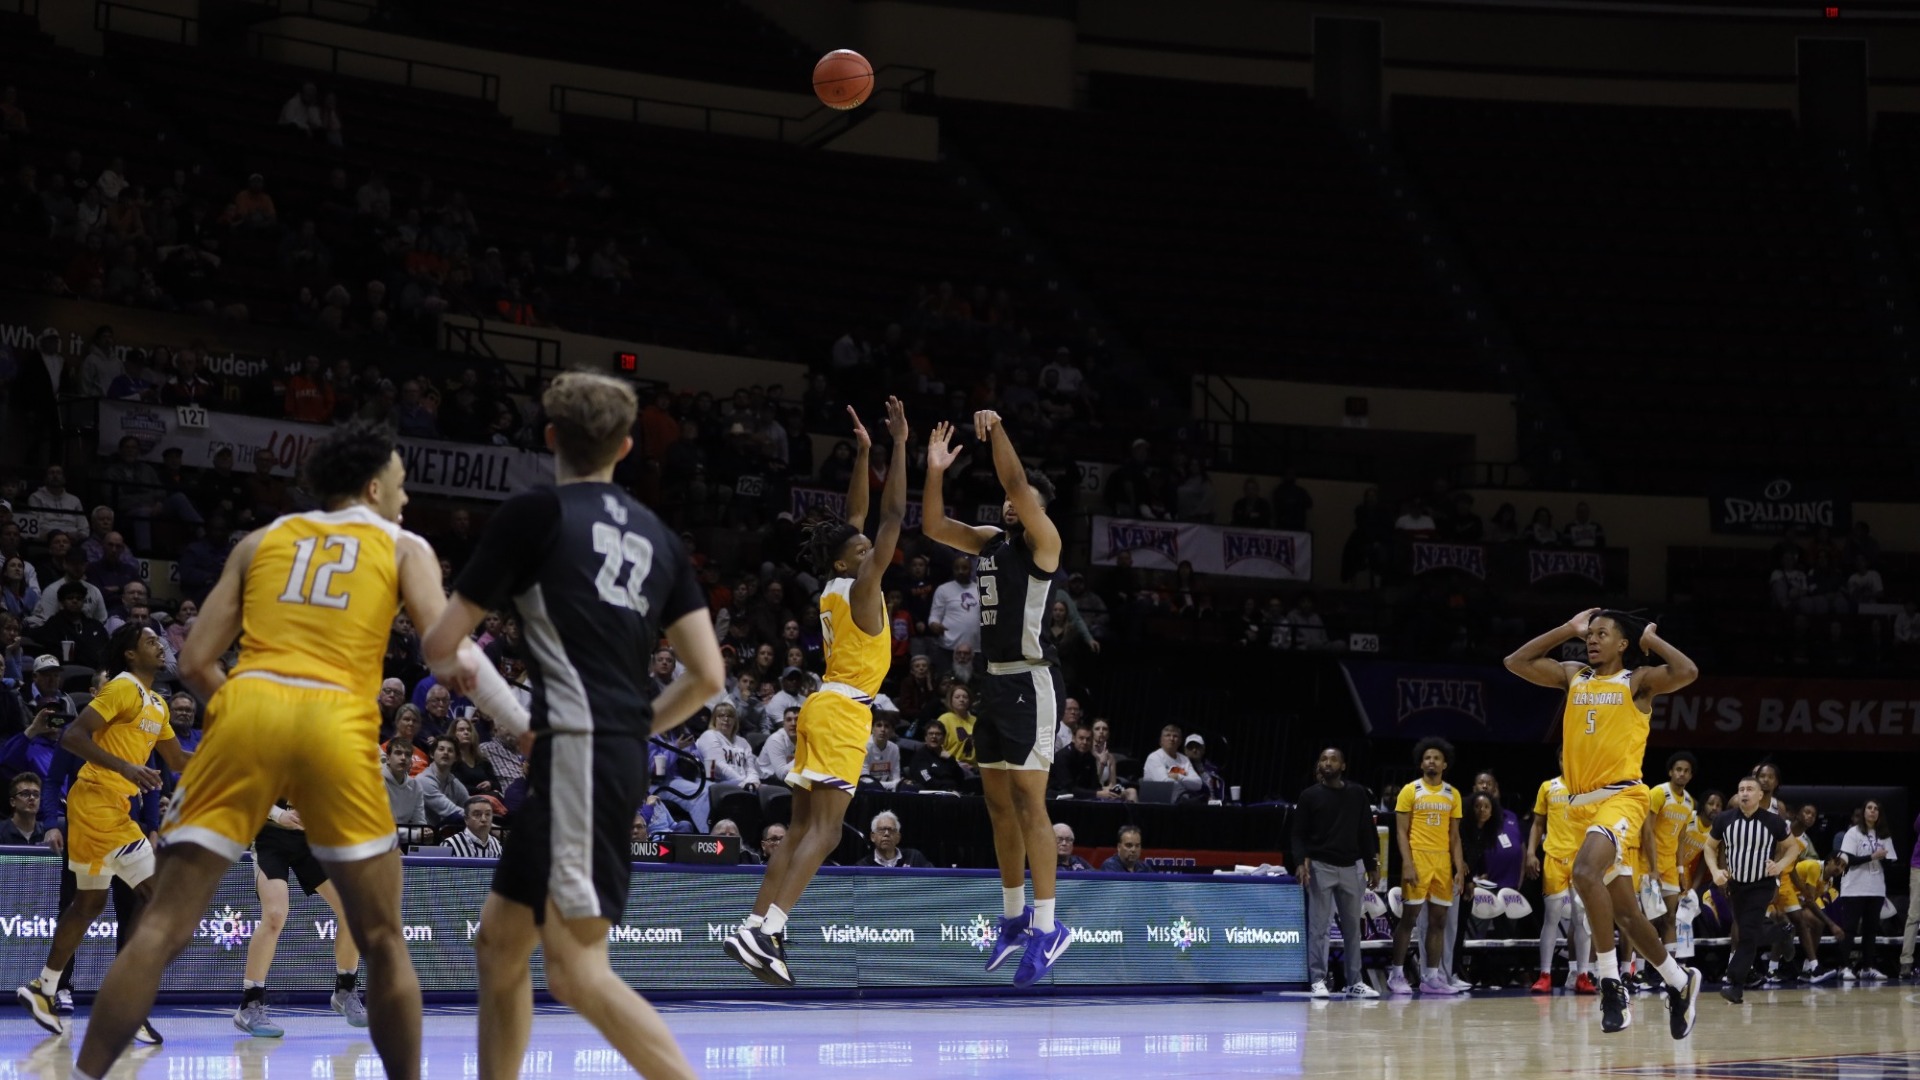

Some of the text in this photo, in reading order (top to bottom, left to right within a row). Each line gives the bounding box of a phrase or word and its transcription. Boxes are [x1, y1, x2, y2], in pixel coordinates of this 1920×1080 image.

[69, 332, 84, 355] it
[180, 410, 205, 426] 127
[266, 430, 314, 468] LOV
[397, 444, 511, 493] KETBALL
[738, 477, 762, 495] 126
[1724, 497, 1834, 527] SPALDING
[1108, 523, 1178, 564] NAIA
[1223, 532, 1296, 574] NAIA
[277, 534, 360, 609] 12
[592, 520, 653, 618] 22
[1412, 542, 1486, 580] NAIA
[1529, 549, 1604, 586] NAIA
[976, 575, 999, 606] 3
[1362, 637, 1377, 651] 26
[1397, 677, 1487, 726] NAIA
[1585, 709, 1598, 735] 5
[697, 841, 718, 854] POSS
[608, 924, 683, 943] tMo.com
[821, 923, 915, 943] VisitMo.com
[1147, 922, 1211, 945] MISSOURI
[1225, 926, 1300, 944] VisitMo.com
